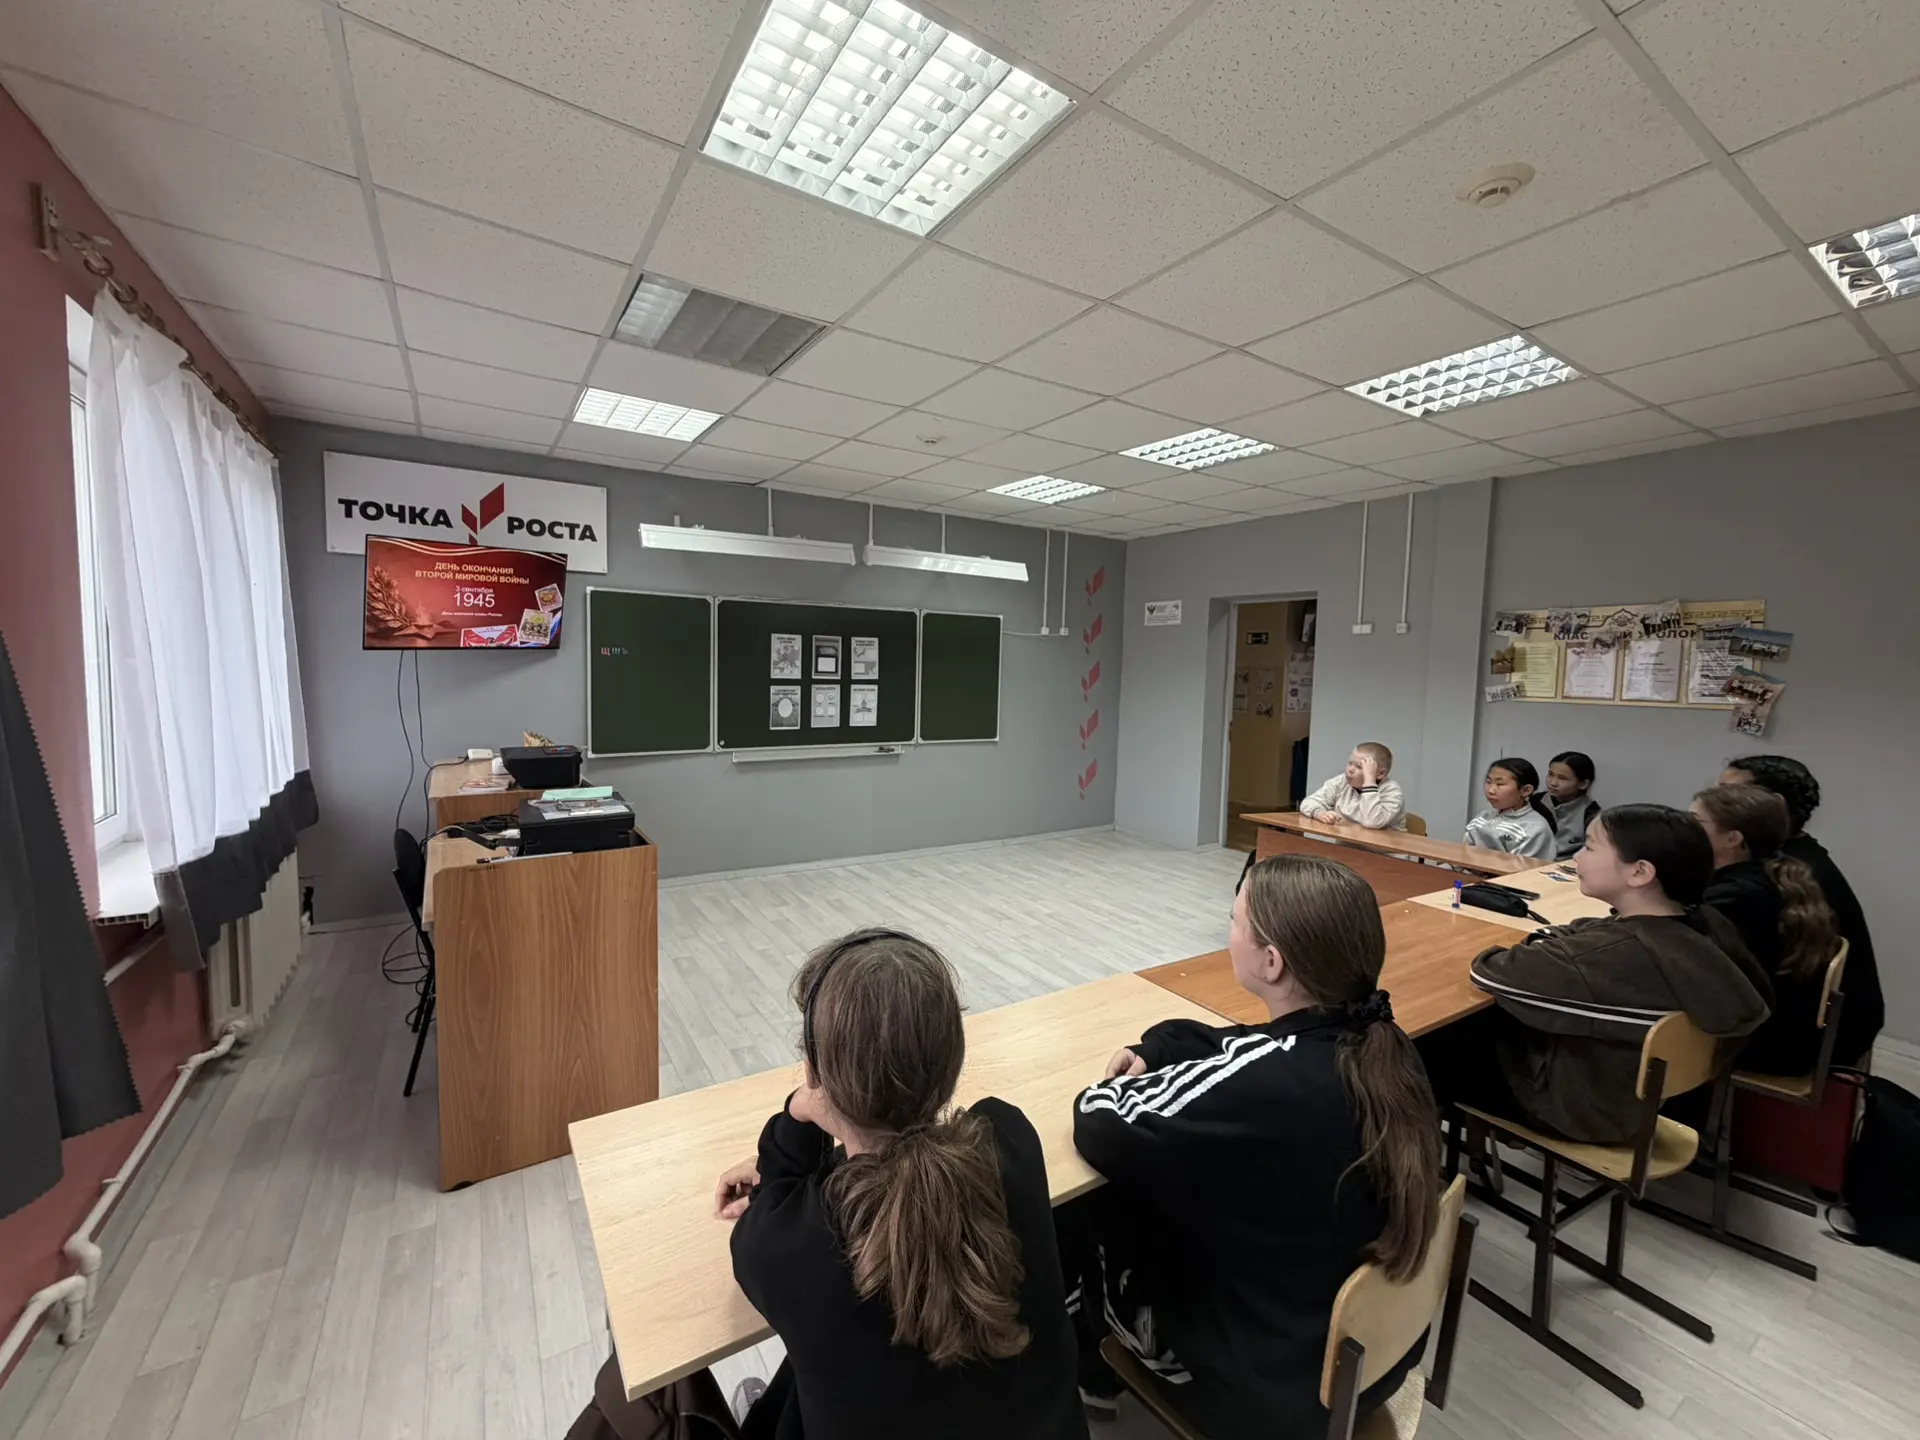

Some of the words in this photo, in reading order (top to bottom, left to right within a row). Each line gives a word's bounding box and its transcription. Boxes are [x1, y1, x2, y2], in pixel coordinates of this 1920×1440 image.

[338, 498, 454, 528] ТОЧКА
[507, 516, 598, 542] РОСТА
[435, 562, 460, 571] ДЕНЬ
[462, 564, 514, 575] ОКОНЧАНИЯ
[415, 570, 453, 579] ВТОРОЙ
[455, 573, 498, 582] МИРОВОЙ
[500, 576, 529, 584] ВОЙНЫ
[453, 592, 495, 608] 1945
